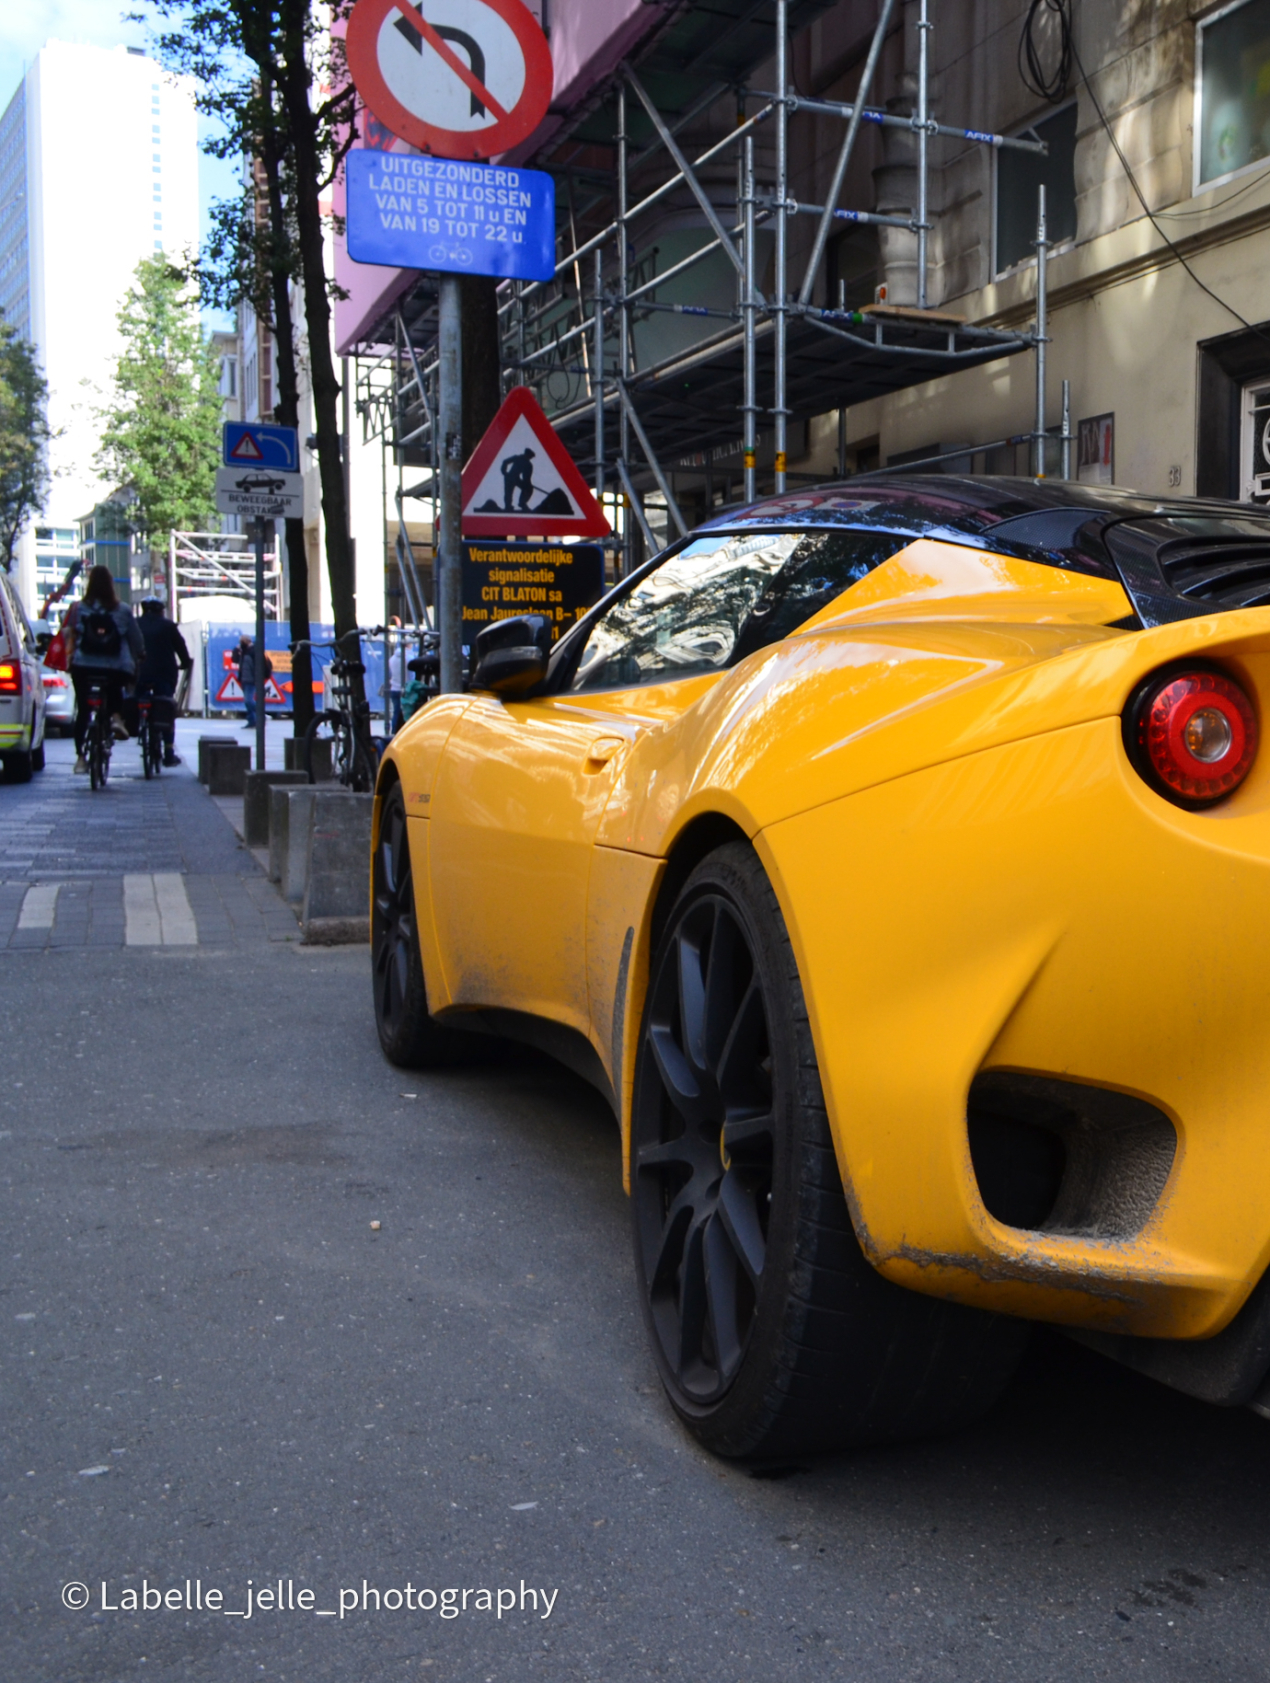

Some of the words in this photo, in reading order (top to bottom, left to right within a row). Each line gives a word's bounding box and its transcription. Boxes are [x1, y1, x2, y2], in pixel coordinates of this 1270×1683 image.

[965, 131, 992, 142] AFIX
[381, 156, 520, 188] UITGEZONDERD
[369, 173, 430, 196] LADEN
[434, 182, 459, 199] EN
[462, 185, 531, 208] LOSSEN
[375, 194, 412, 213] VAN
[416, 198, 429, 214] 5
[434, 200, 468, 219] TOT
[474, 205, 485, 221] 11
[489, 210, 500, 222] u
[504, 209, 527, 225] EN
[379, 212, 417, 231] VAN
[421, 218, 440, 234] 19
[444, 220, 480, 238] TOT
[484, 224, 508, 241] 22
[1168, 466, 1182, 487] 33
[228, 493, 292, 506] BEWEEGBAAR
[237, 504, 285, 514] OBSTA
[469, 547, 573, 567] Verantwoordelijke
[488, 567, 555, 585] signalisatie
[481, 586, 501, 601] CIT
[502, 587, 546, 602] BLATON
[549, 590, 563, 602] sa
[462, 606, 488, 621] Jean
